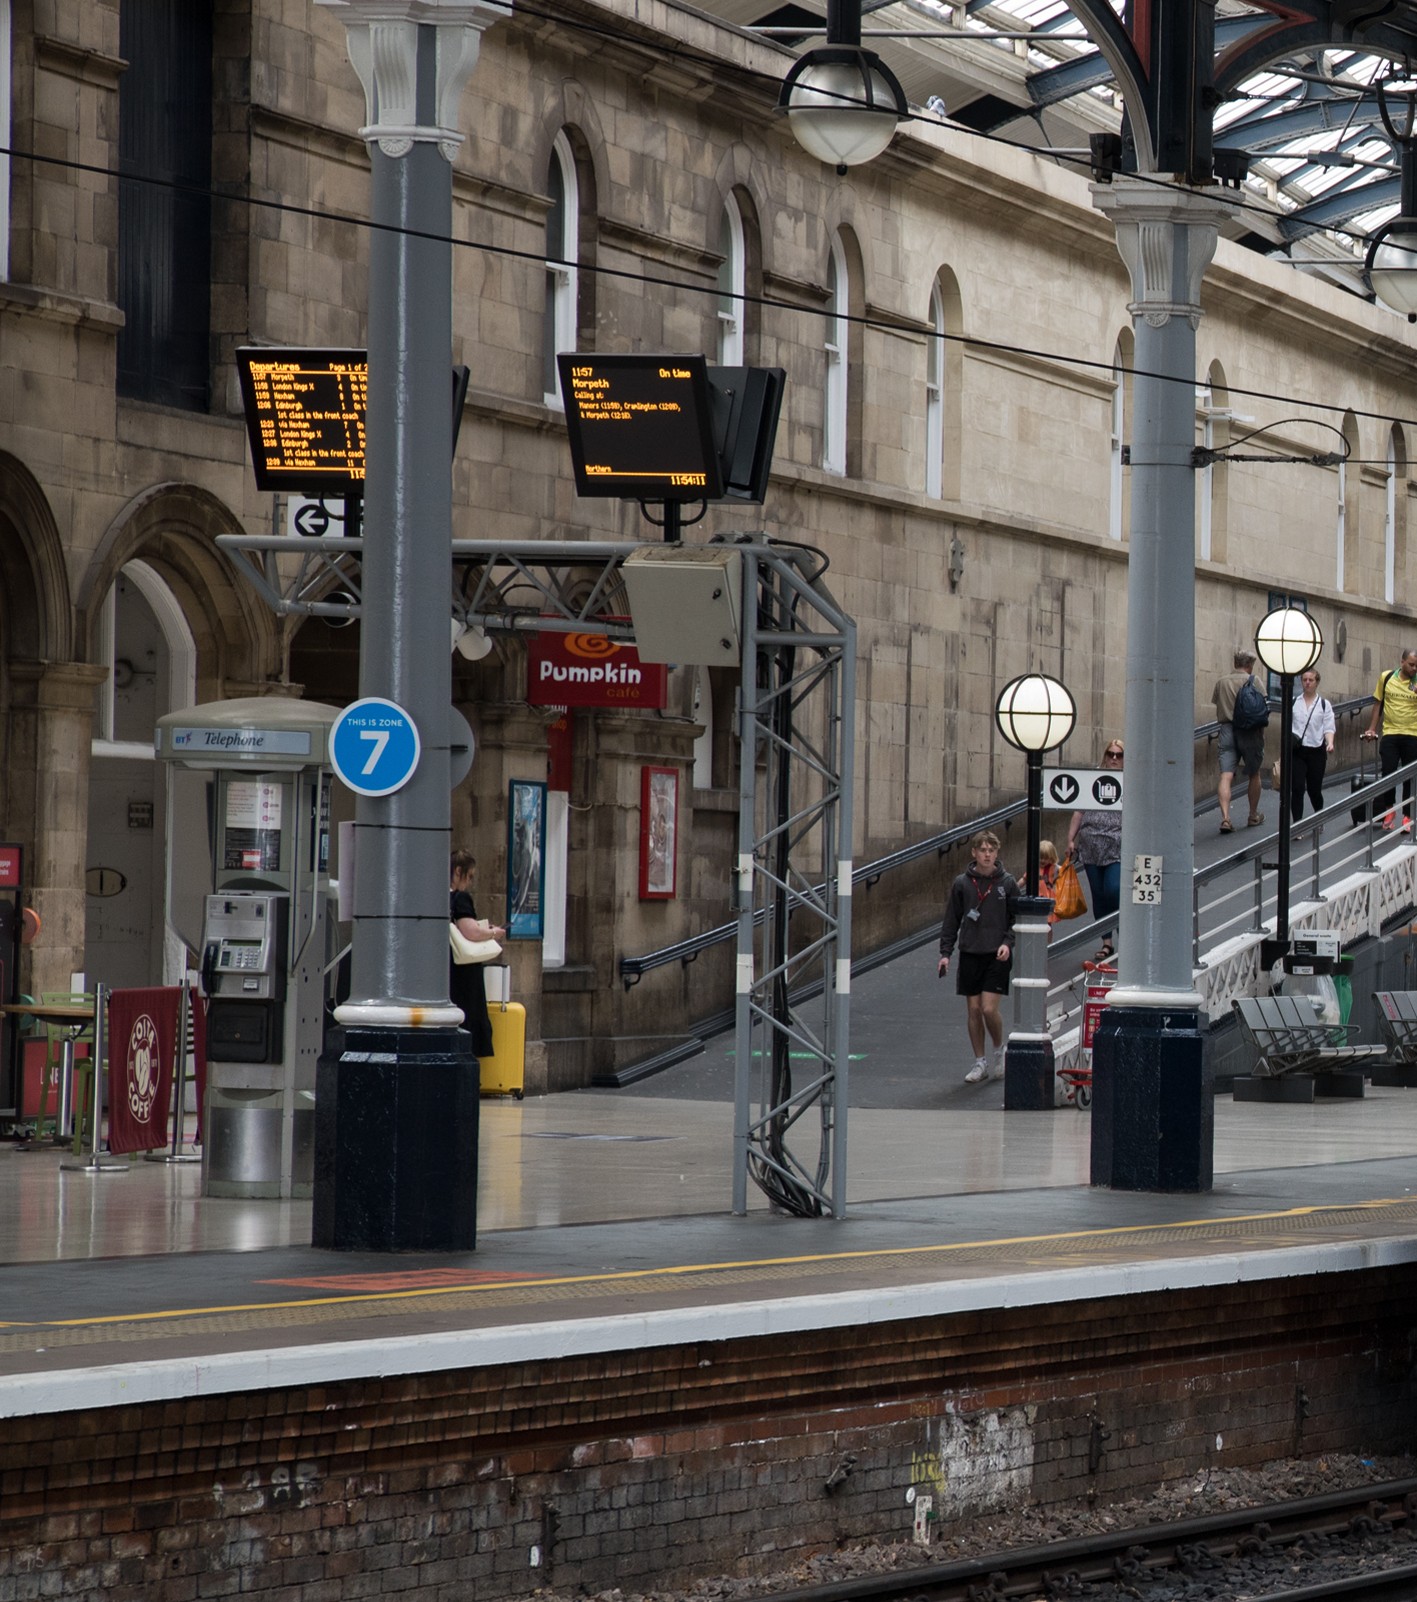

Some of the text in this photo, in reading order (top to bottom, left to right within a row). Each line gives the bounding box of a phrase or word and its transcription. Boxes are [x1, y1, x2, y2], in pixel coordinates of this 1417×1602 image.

[249, 361, 300, 372] Departures
[329, 363, 346, 373] Page
[354, 363, 362, 372] of
[572, 367, 692, 378] 11:57 On time
[271, 374, 295, 382] Morpeth
[272, 383, 293, 391] London
[293, 383, 308, 392] Kings
[572, 379, 610, 390] Morpeth
[274, 392, 296, 400] Hexham
[574, 391, 595, 400] Calling
[275, 402, 302, 412] Edinburgh
[579, 402, 600, 410] Manors
[288, 411, 305, 420] class
[305, 411, 312, 420] in
[312, 411, 323, 420] the
[324, 411, 341, 420] front
[586, 412, 610, 420] Morpeth
[289, 420, 310, 428] Hexham
[280, 430, 300, 439] London
[300, 430, 316, 439] Kings
[281, 440, 309, 449] Edinburgh
[295, 449, 311, 457] class
[311, 449, 317, 457] in
[318, 449, 329, 457] the
[330, 449, 347, 458] front
[348, 450, 365, 458] coach
[294, 459, 316, 467] Hexham
[585, 464, 612, 473] Northern
[670, 475, 706, 486] 11:54:11
[540, 660, 642, 684] Pumpkin
[347, 718, 367, 726] THIS
[379, 718, 403, 727] ZONE
[175, 731, 265, 748] BT Telephone
[359, 730, 390, 775] 7
[1144, 858, 1151, 869] E
[1135, 874, 1161, 886] 432
[1138, 890, 1154, 902] 35
